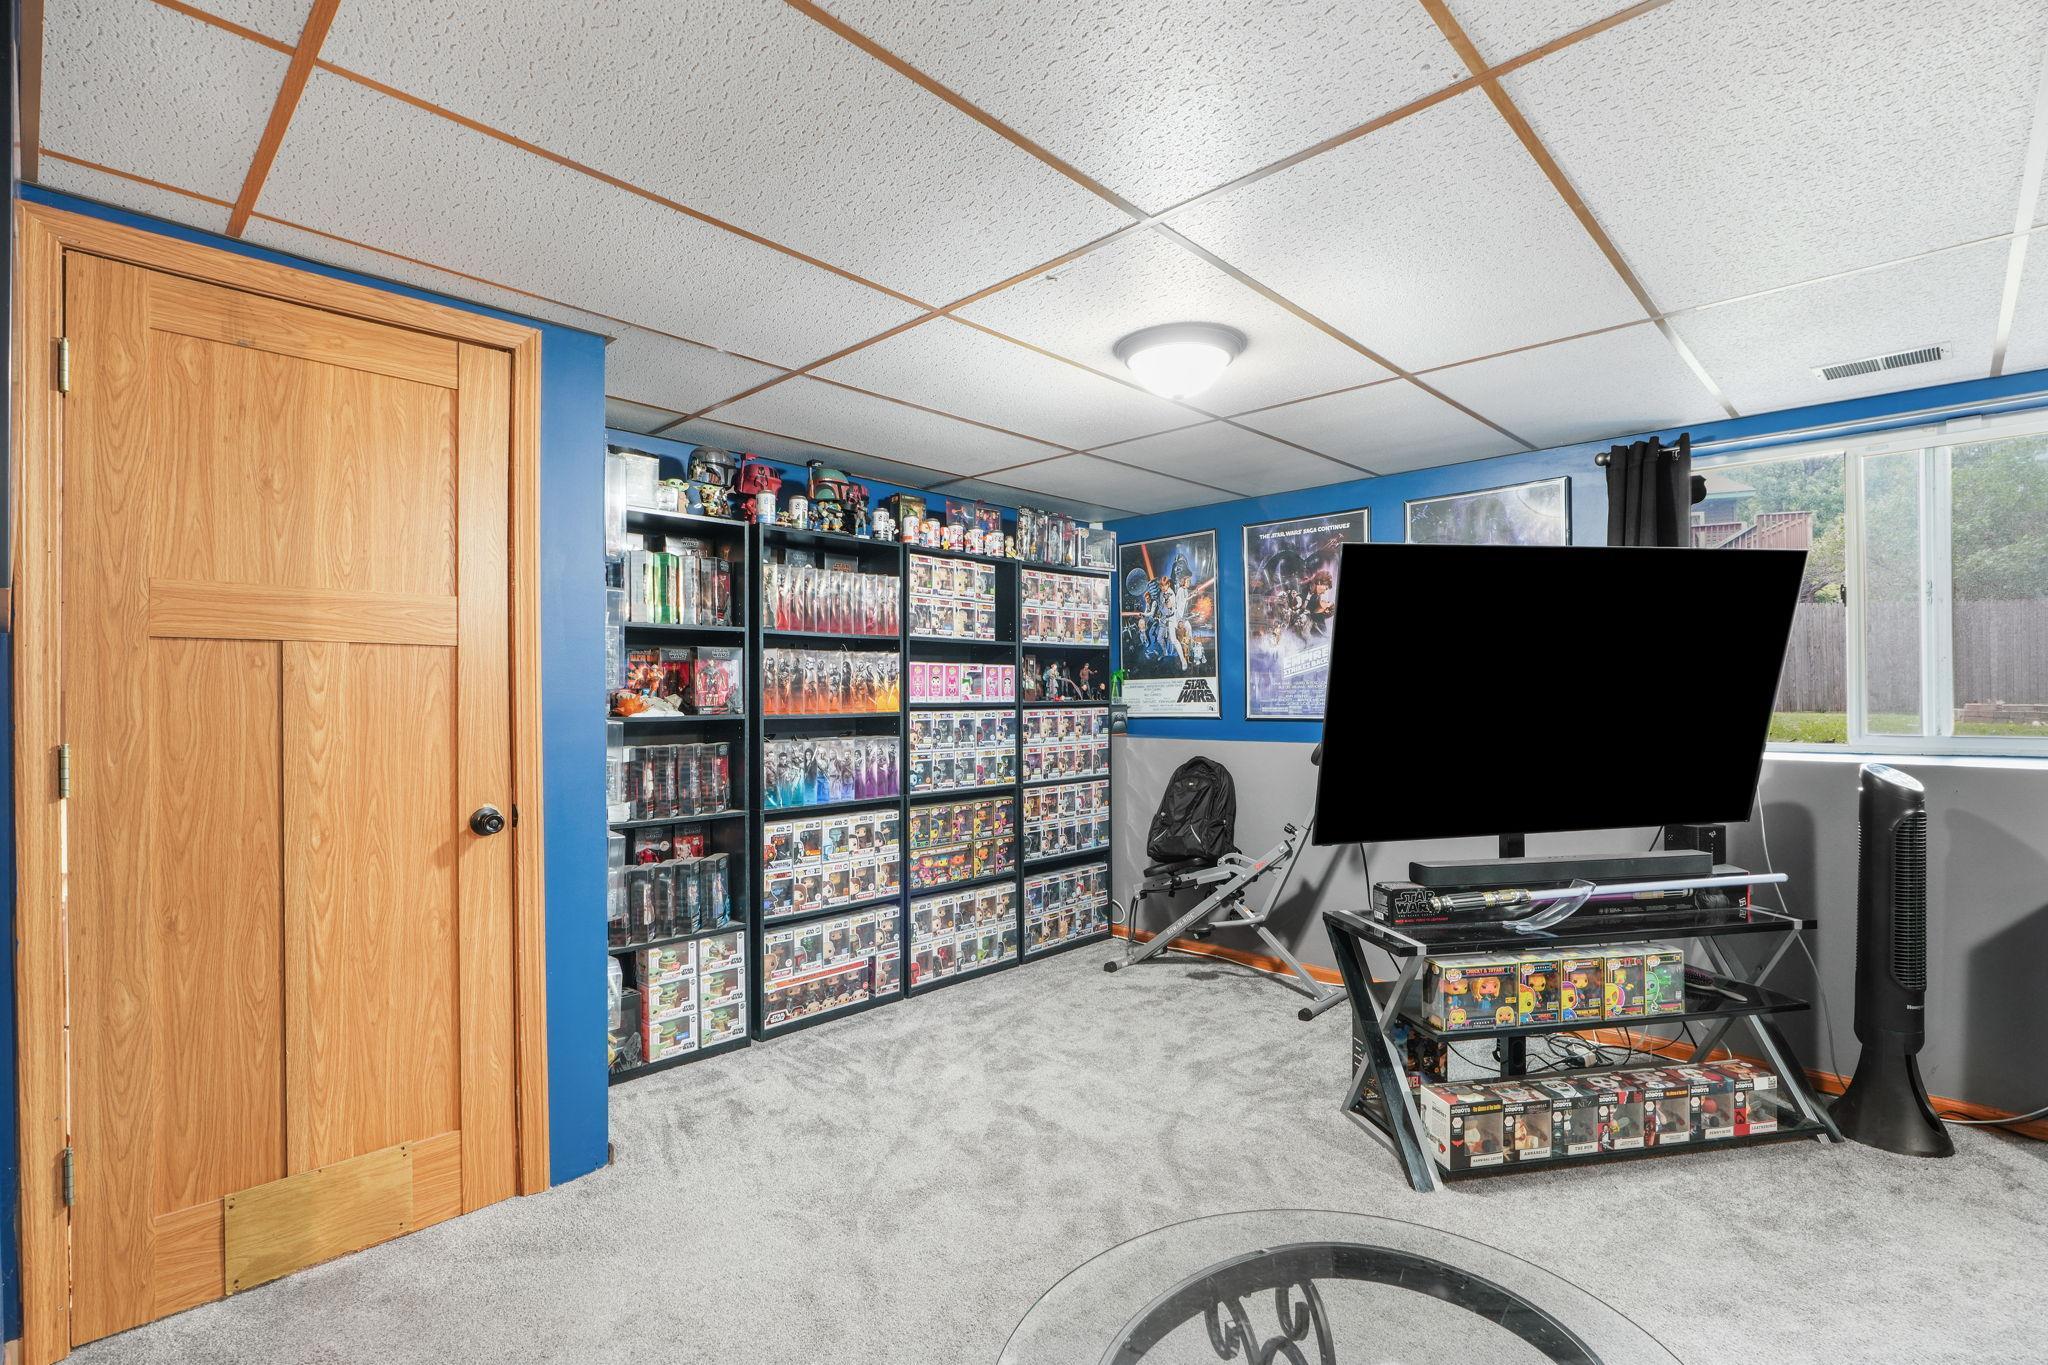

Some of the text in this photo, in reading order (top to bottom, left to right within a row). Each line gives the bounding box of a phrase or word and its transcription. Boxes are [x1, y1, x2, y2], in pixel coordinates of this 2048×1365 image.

[1271, 531, 1286, 539] STAR
[1285, 529, 1303, 537] WARS
[1303, 527, 1318, 535] SAGA
[1317, 522, 1351, 532] CONTINUES
[1183, 679, 1210, 690] STAR
[1177, 690, 1216, 703] WARS
[1395, 891, 1436, 904] STAR
